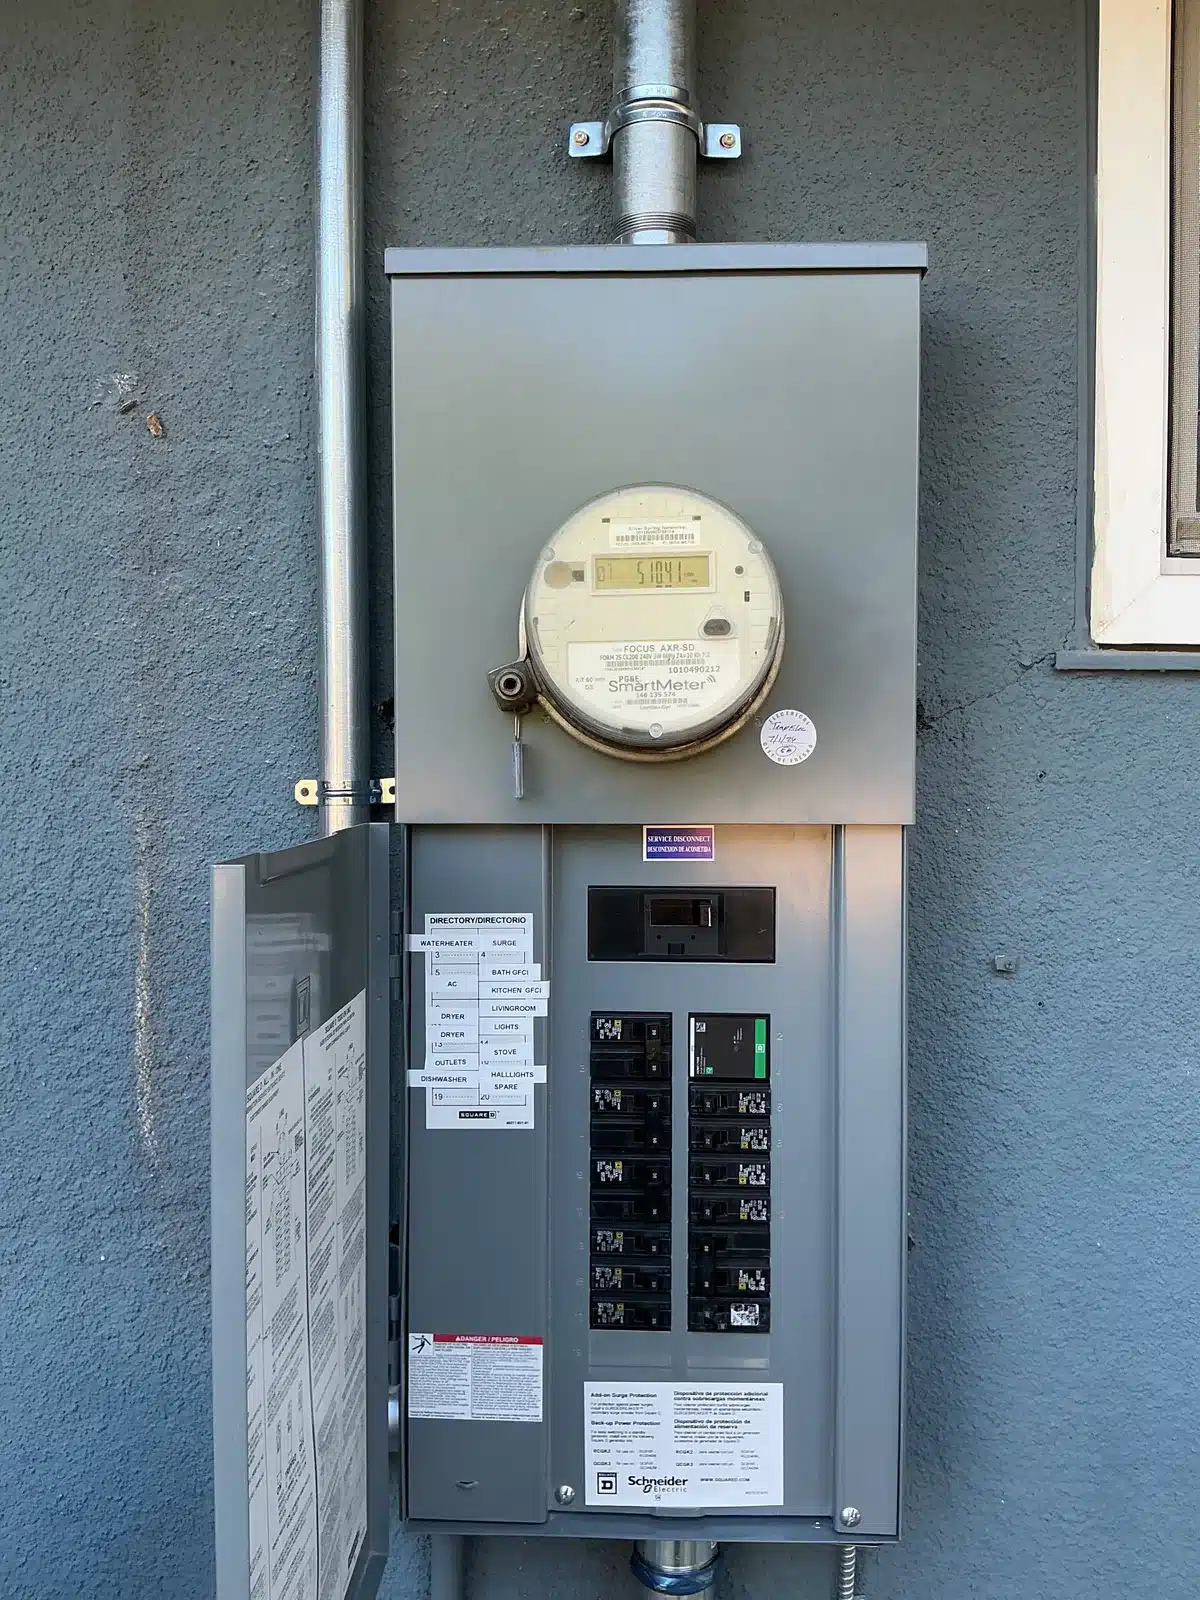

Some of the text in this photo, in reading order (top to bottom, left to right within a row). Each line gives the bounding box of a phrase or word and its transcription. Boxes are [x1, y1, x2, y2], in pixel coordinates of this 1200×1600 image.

[660, 644, 695, 652] AXR-SD
[608, 679, 706, 692] SmartMeter
[601, 1480, 613, 1490] D
[628, 1476, 688, 1486] Schneider
